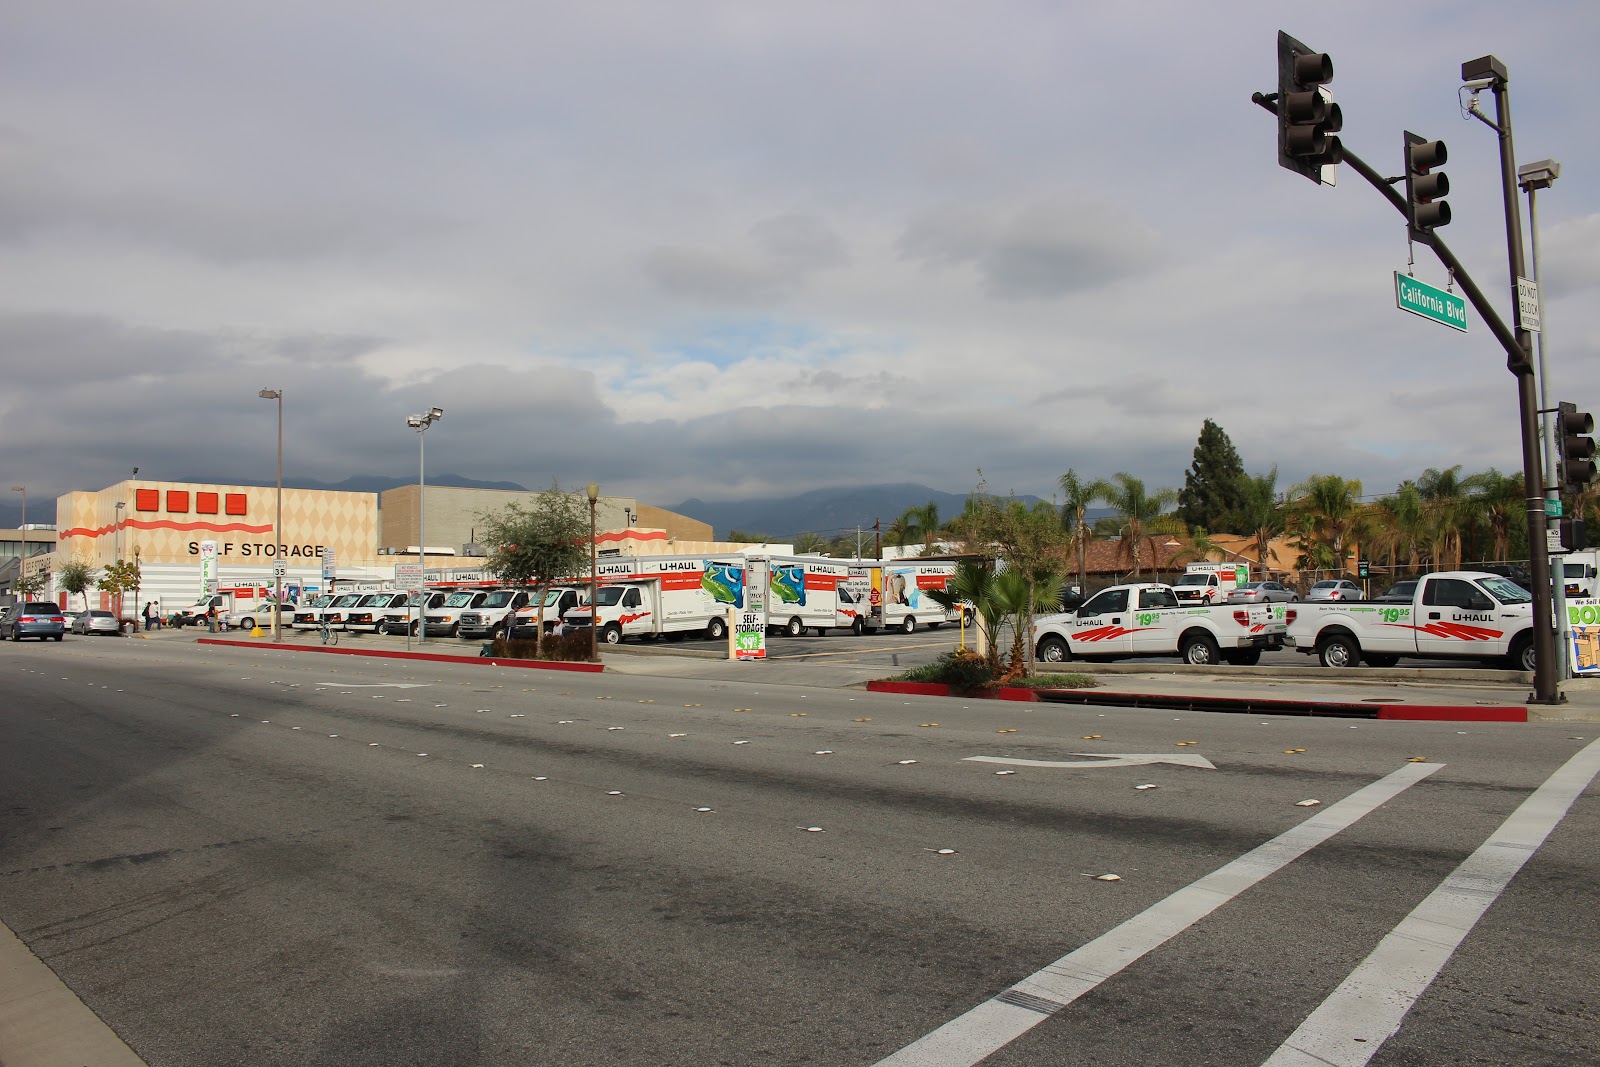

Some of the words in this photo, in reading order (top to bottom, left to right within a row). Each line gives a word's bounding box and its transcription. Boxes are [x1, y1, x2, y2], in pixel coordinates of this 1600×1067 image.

[1519, 284, 1527, 297] DO
[1527, 286, 1537, 300] NOT
[1400, 282, 1443, 314] California
[1446, 300, 1465, 322] Blvd
[1520, 300, 1539, 316] BLOCK
[241, 543, 324, 558] STORAGE
[598, 564, 631, 575] U-HAUL
[659, 561, 697, 571] U-HAUL
[809, 565, 836, 574] U-HAUL
[275, 568, 285, 576] 35
[456, 573, 480, 581] U-HAUL
[743, 614, 759, 624] SELF-
[1453, 613, 1494, 622] U-HAUL
[735, 623, 764, 633] STORAGE
